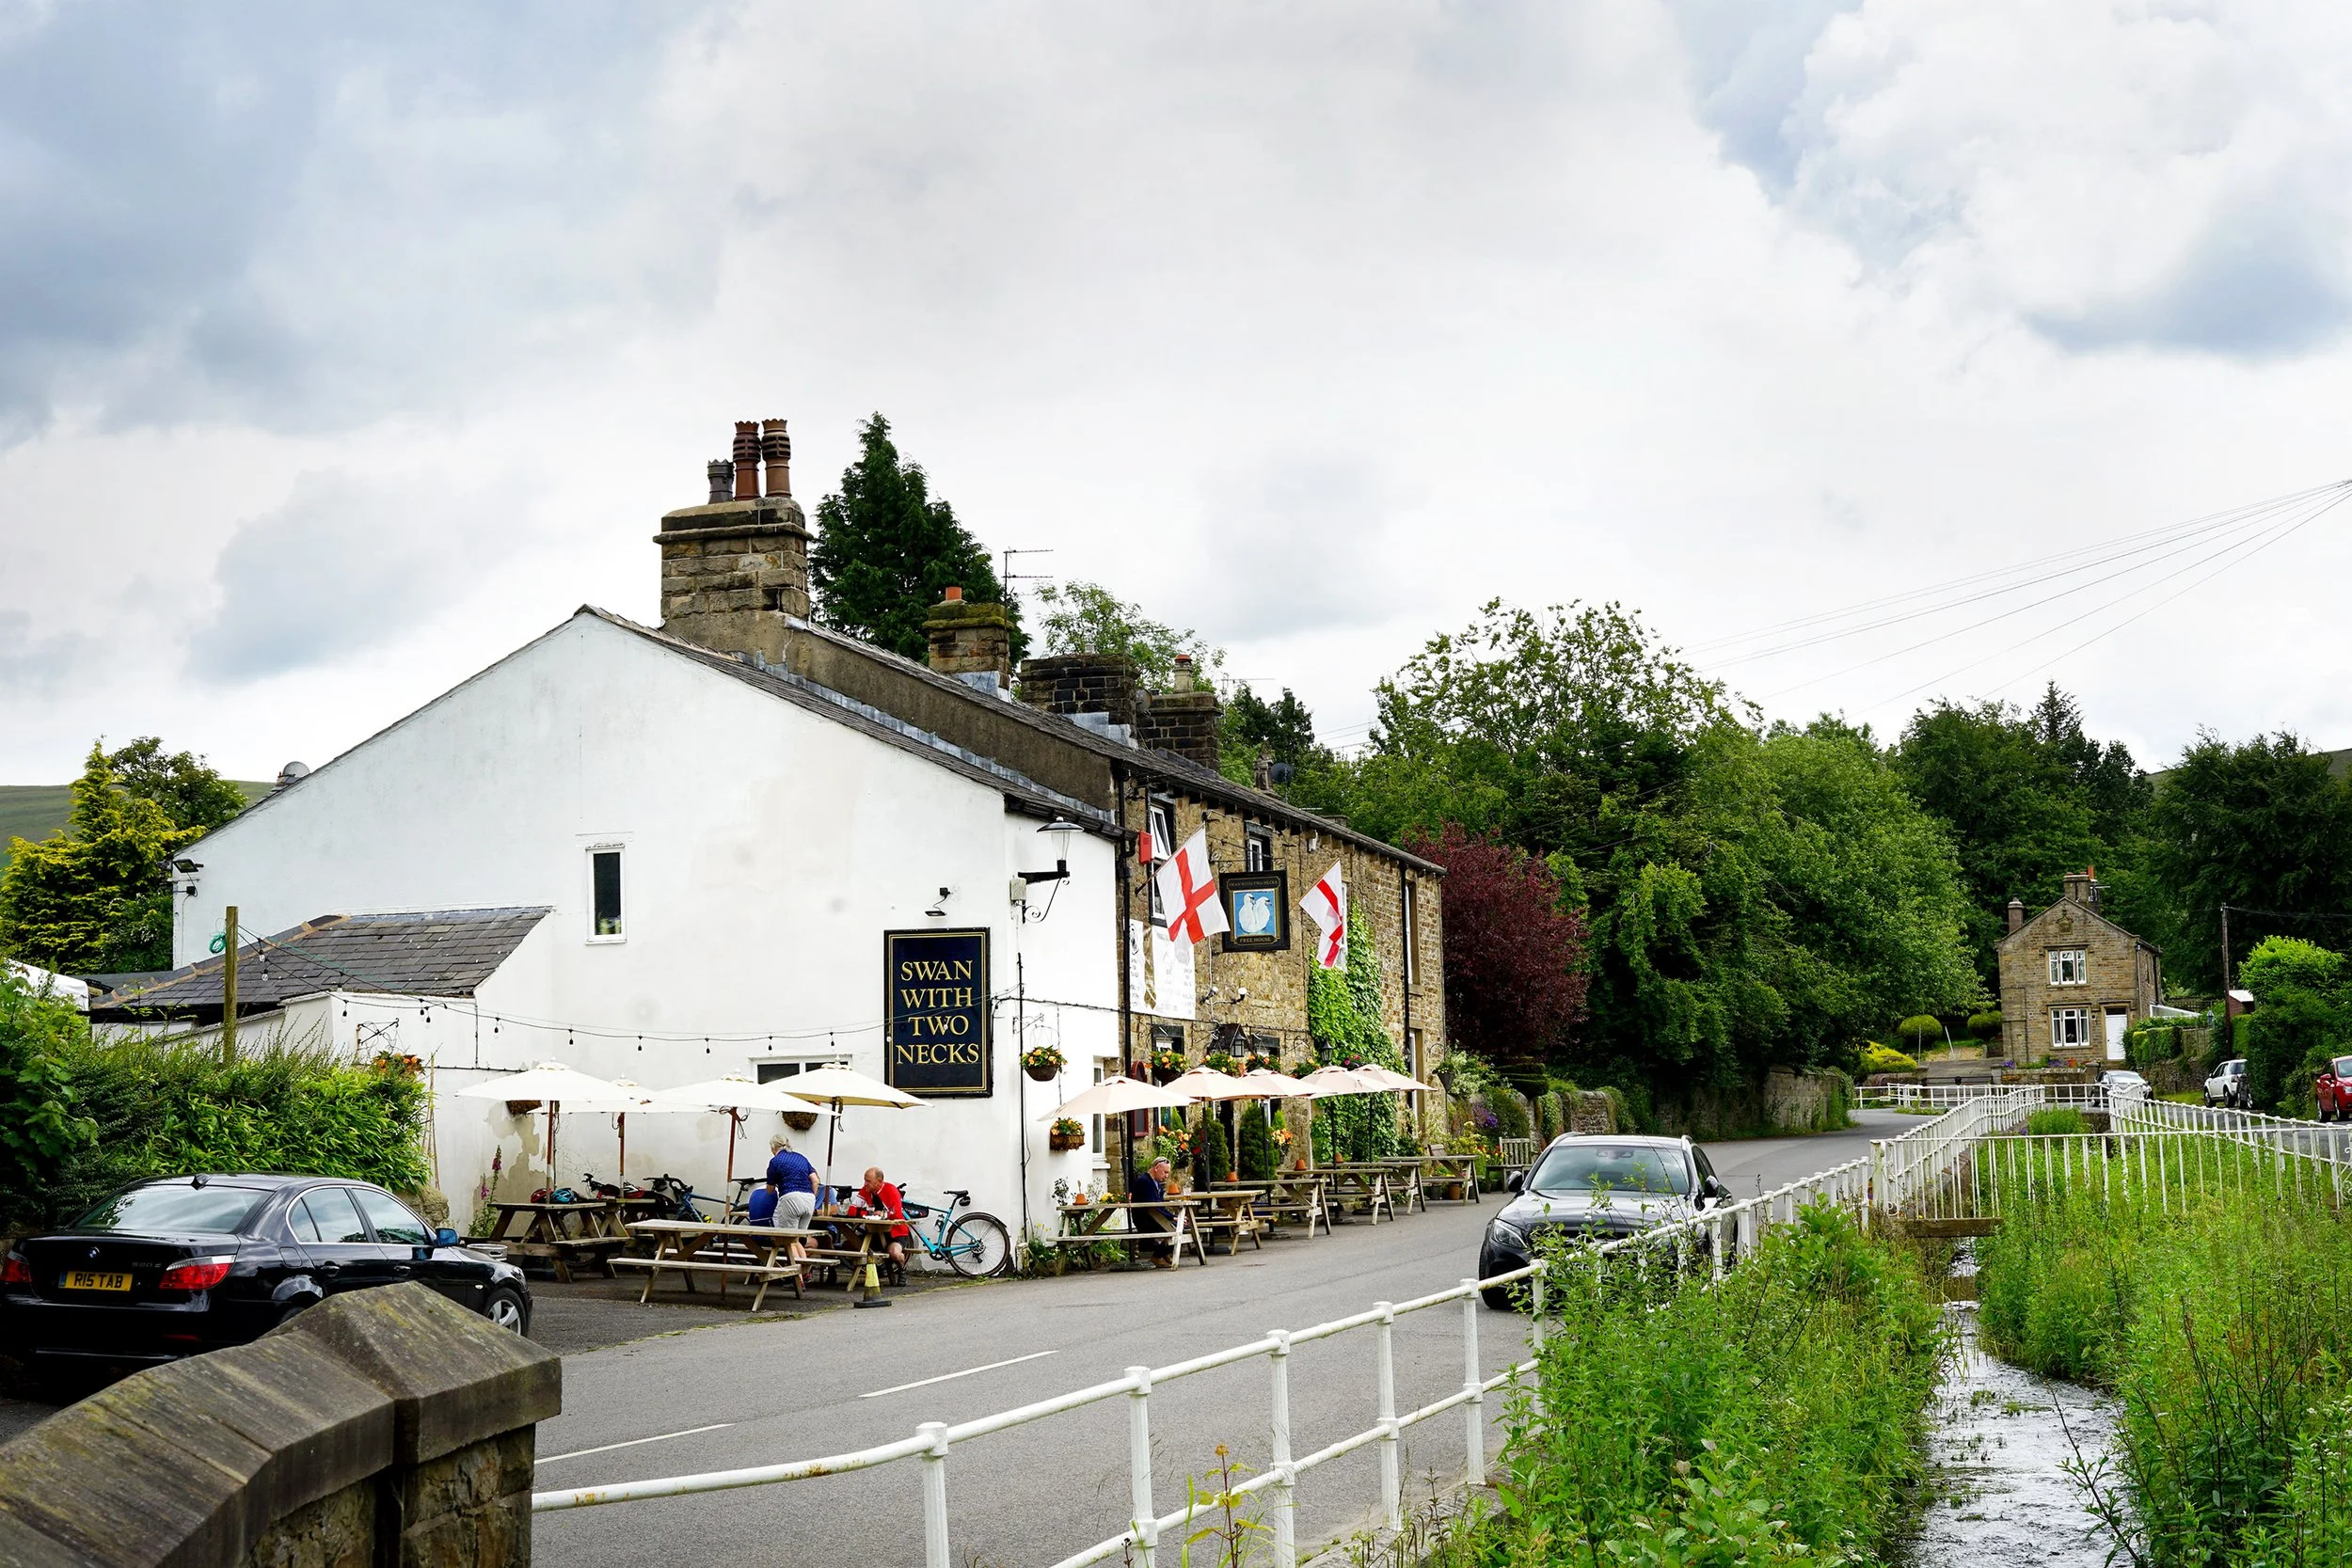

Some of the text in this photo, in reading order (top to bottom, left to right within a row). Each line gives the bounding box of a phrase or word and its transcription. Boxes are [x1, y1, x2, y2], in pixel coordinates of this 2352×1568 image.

[900, 959, 973, 981] SWAN
[900, 987, 974, 1008] WITH
[908, 1015, 969, 1037] TWO
[896, 1043, 979, 1065] NECKS
[73, 1273, 124, 1289] R15 TAB
